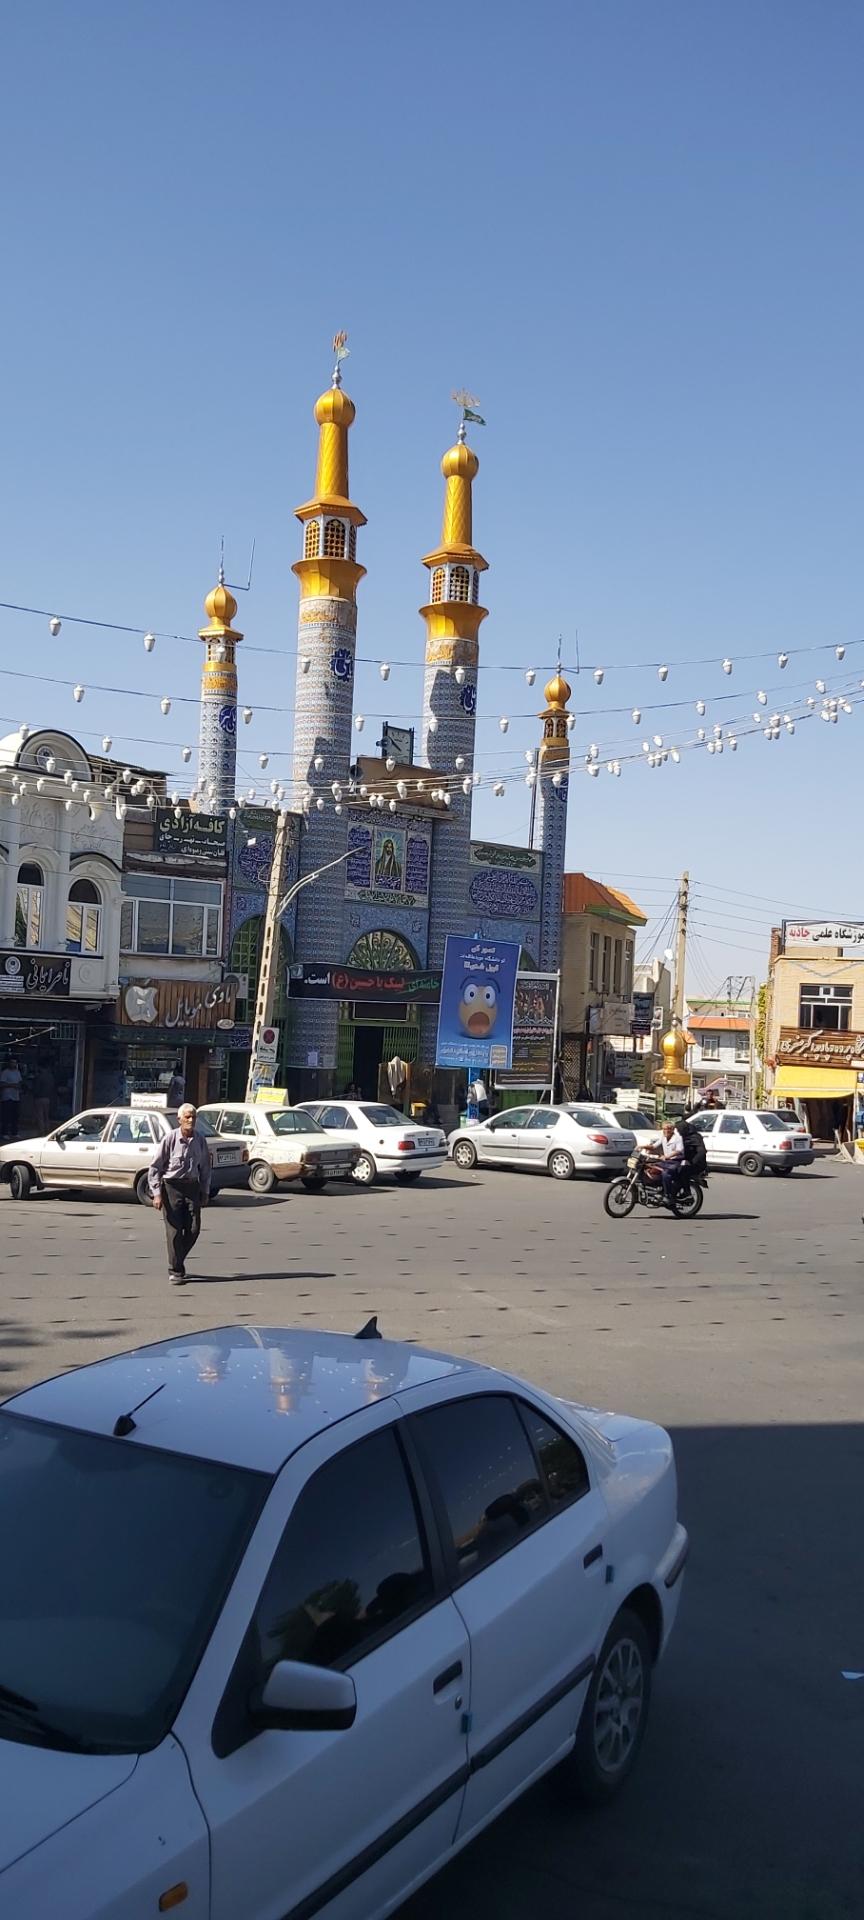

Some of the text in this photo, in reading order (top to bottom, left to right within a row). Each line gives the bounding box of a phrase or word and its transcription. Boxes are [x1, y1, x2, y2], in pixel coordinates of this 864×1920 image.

[159, 814, 226, 834] کافه آزادی
[788, 927, 810, 938] جاذبه
[812, 927, 833, 941] علمی
[46, 961, 71, 993] ناصر
[349, 978, 375, 991] حسین
[165, 997, 202, 1028] موبایل
